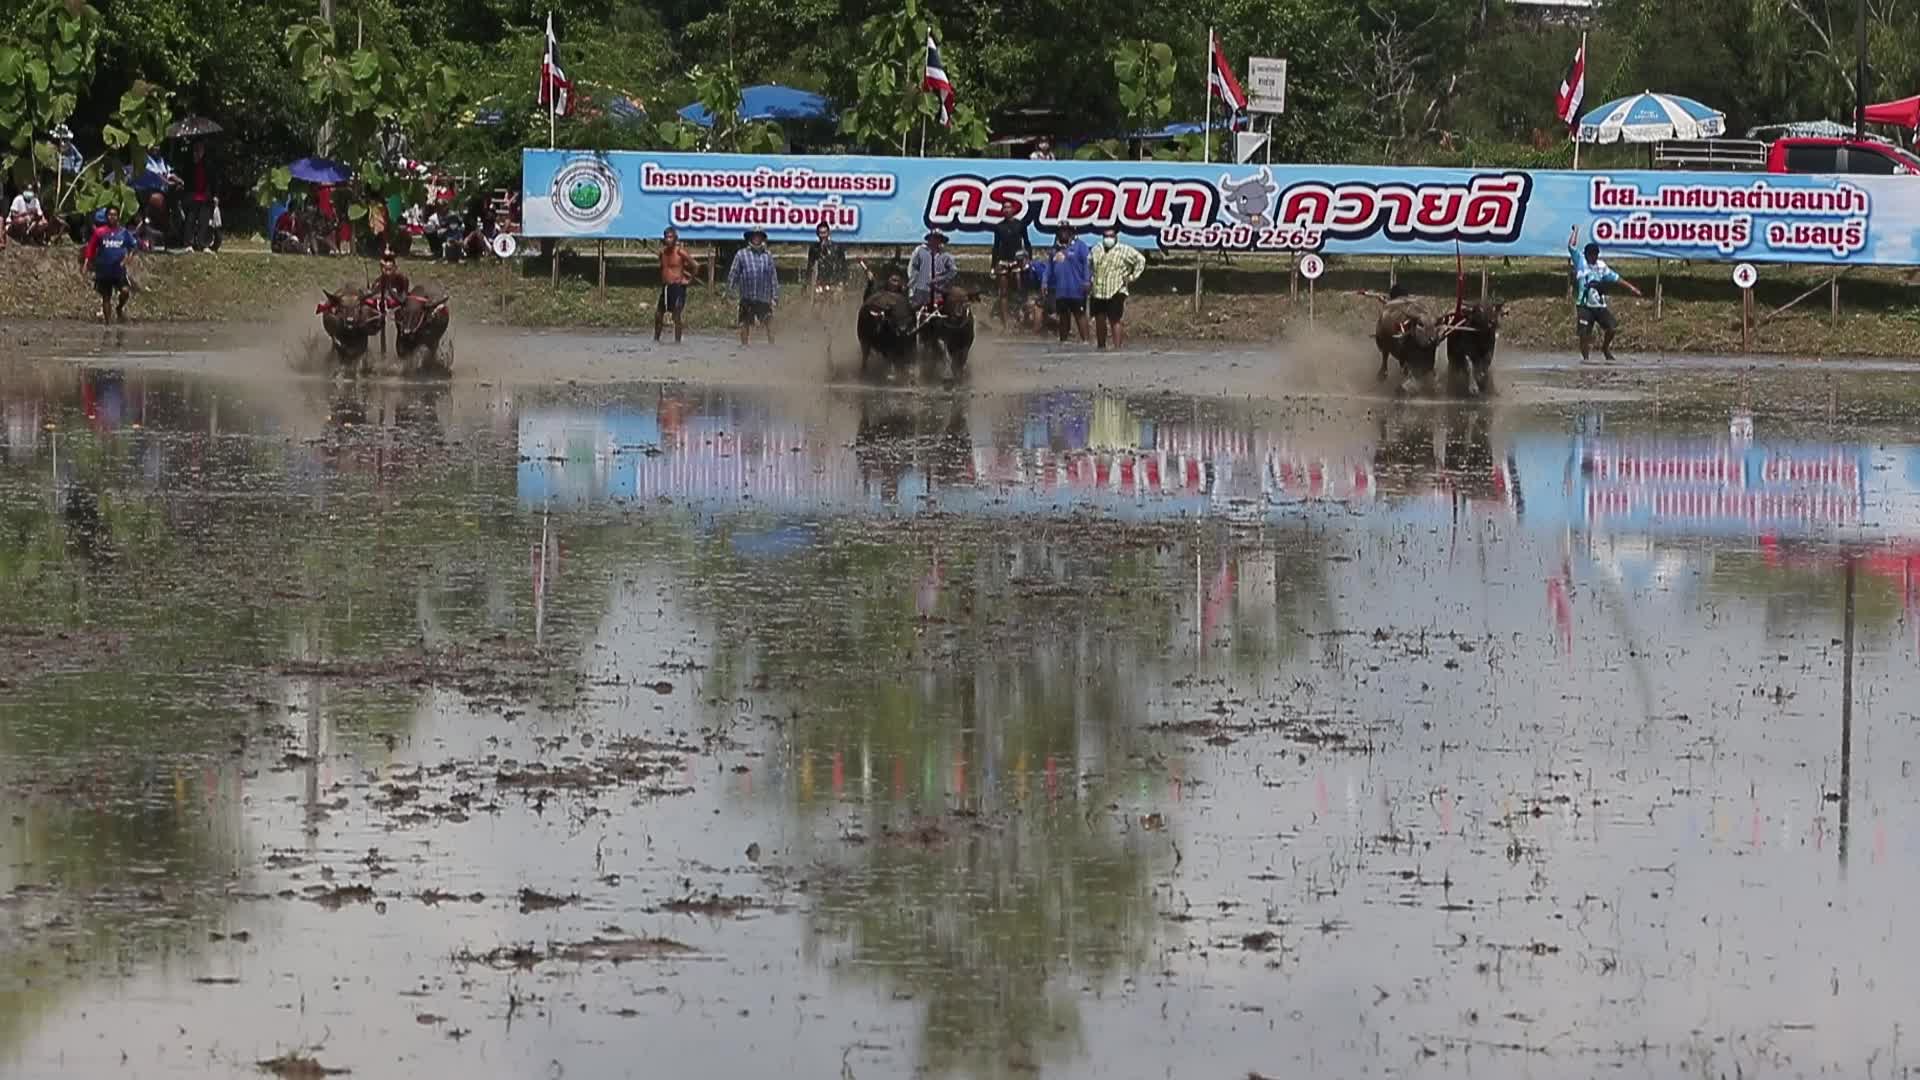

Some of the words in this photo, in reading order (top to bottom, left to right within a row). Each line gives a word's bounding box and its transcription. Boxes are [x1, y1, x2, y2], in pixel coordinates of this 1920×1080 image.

[644, 166, 892, 193] โครงการอนุรักษ์วัฒนธรรม
[674, 198, 855, 226] ประเพณีท้องถิ่น
[935, 184, 1208, 222] คราดนา
[1282, 182, 1519, 229] ควายดี
[1162, 225, 1250, 246] ประจำปี
[1258, 229, 1320, 246] 2565
[1596, 216, 1748, 248] อ.เมืองชลบุรี
[1770, 221, 1862, 252] จ.ชลบุรี
[1739, 269, 1750, 281] 4
